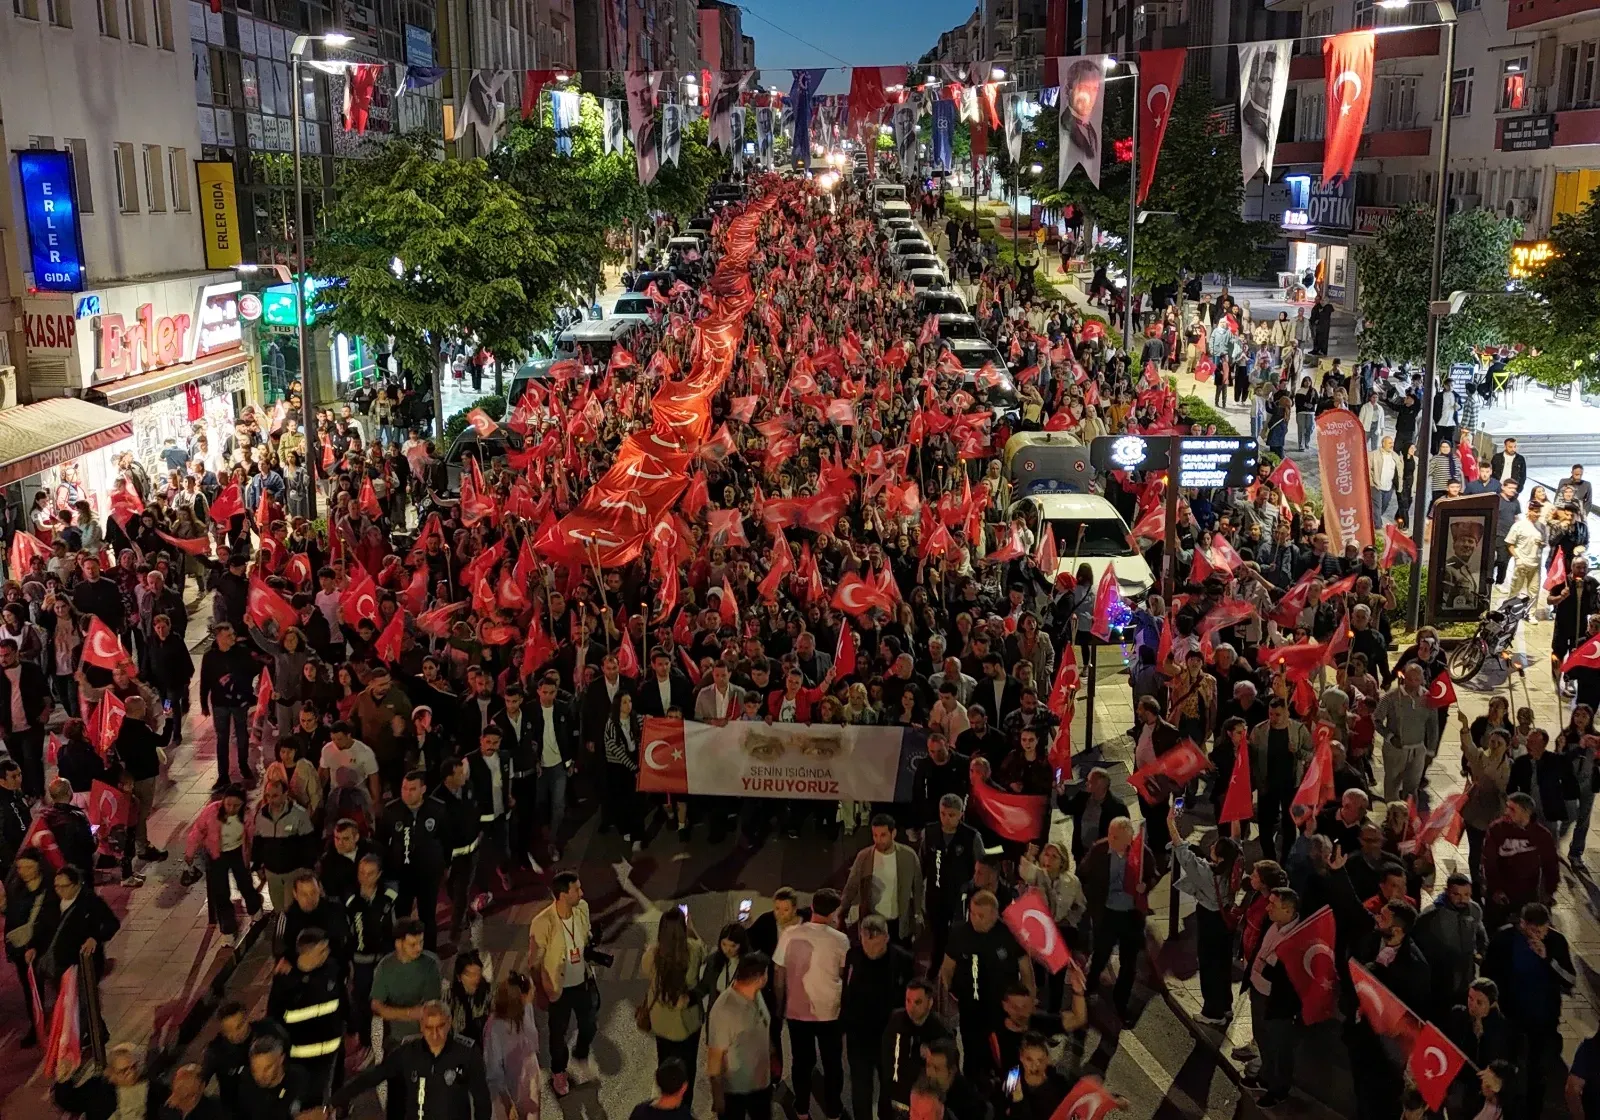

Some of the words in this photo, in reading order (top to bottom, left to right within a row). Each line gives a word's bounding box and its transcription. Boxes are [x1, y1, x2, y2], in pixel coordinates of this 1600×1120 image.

[212, 182, 225, 210] GIDA
[42, 182, 61, 263] ERLER
[215, 212, 229, 250] ERLER
[44, 272, 71, 282] GIDA
[23, 313, 75, 348] KASAP
[94, 303, 191, 379] Erler
[273, 325, 291, 333] TEB
[40, 440, 84, 470] PYRAMID
[1205, 441, 1239, 449] MEYDANI
[750, 765, 782, 776] SENİN
